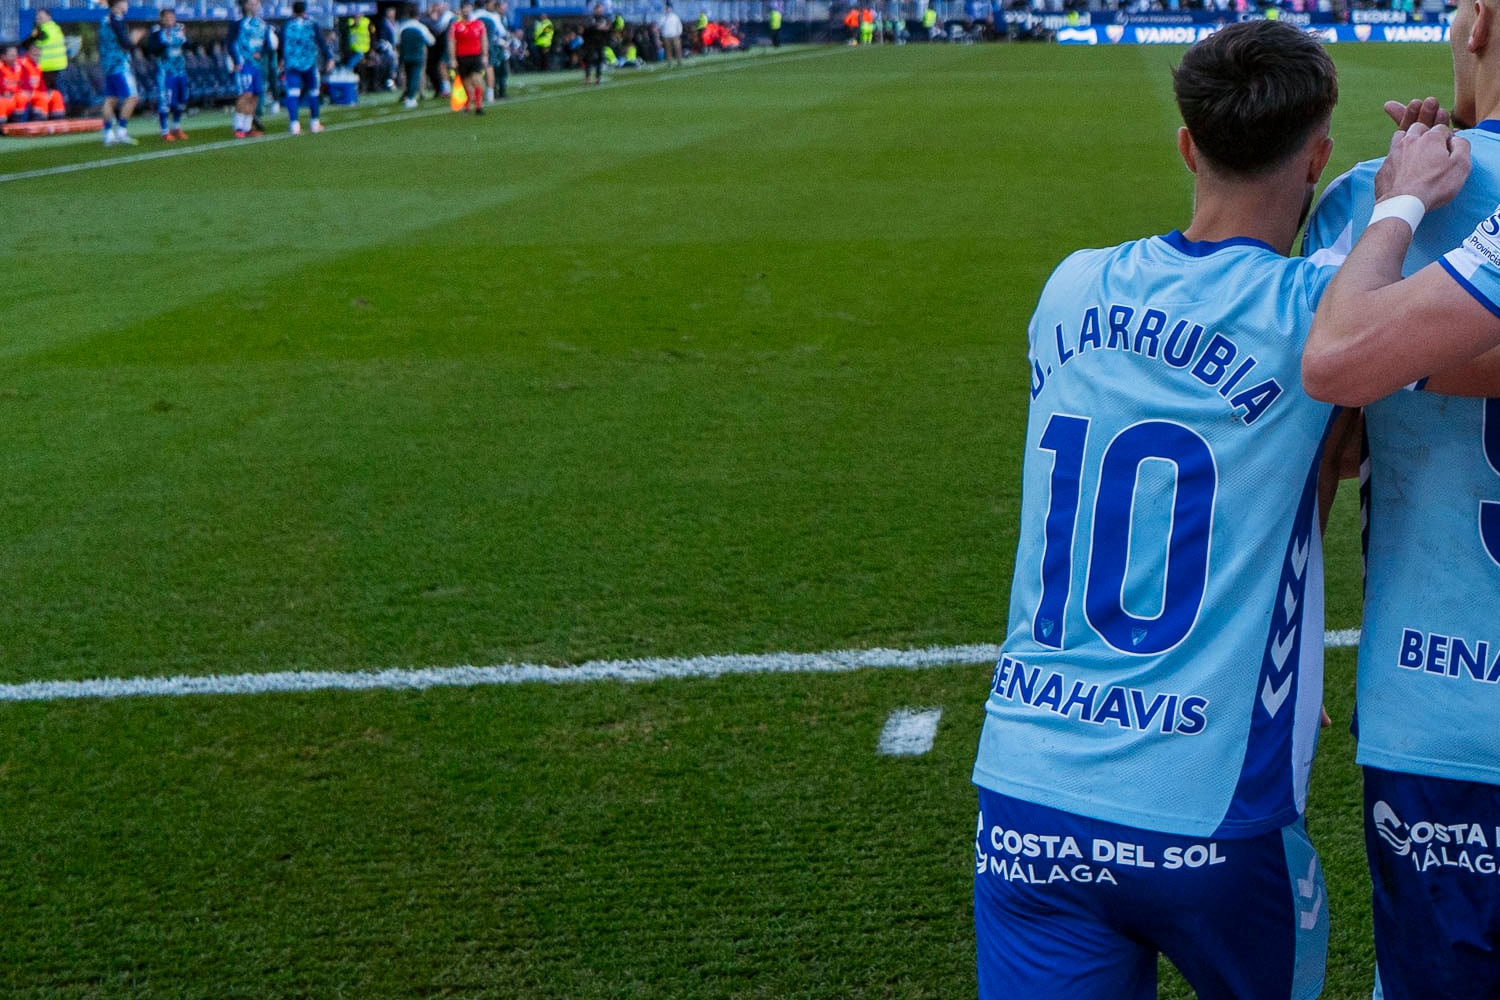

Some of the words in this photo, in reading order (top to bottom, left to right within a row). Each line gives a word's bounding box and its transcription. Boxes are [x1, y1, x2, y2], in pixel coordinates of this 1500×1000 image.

[1134, 27, 1197, 44] VAMOS
[1384, 26, 1442, 43] VAMOS
[1054, 303, 1285, 427] LARRUBIA
[1032, 412, 1218, 657] 10
[990, 825, 1083, 861] COSTA
[1092, 838, 1155, 869] DEL
[1164, 842, 1227, 869] SOL
[1404, 820, 1488, 851] OSTA
[990, 858, 1118, 886] MÁLAGA
